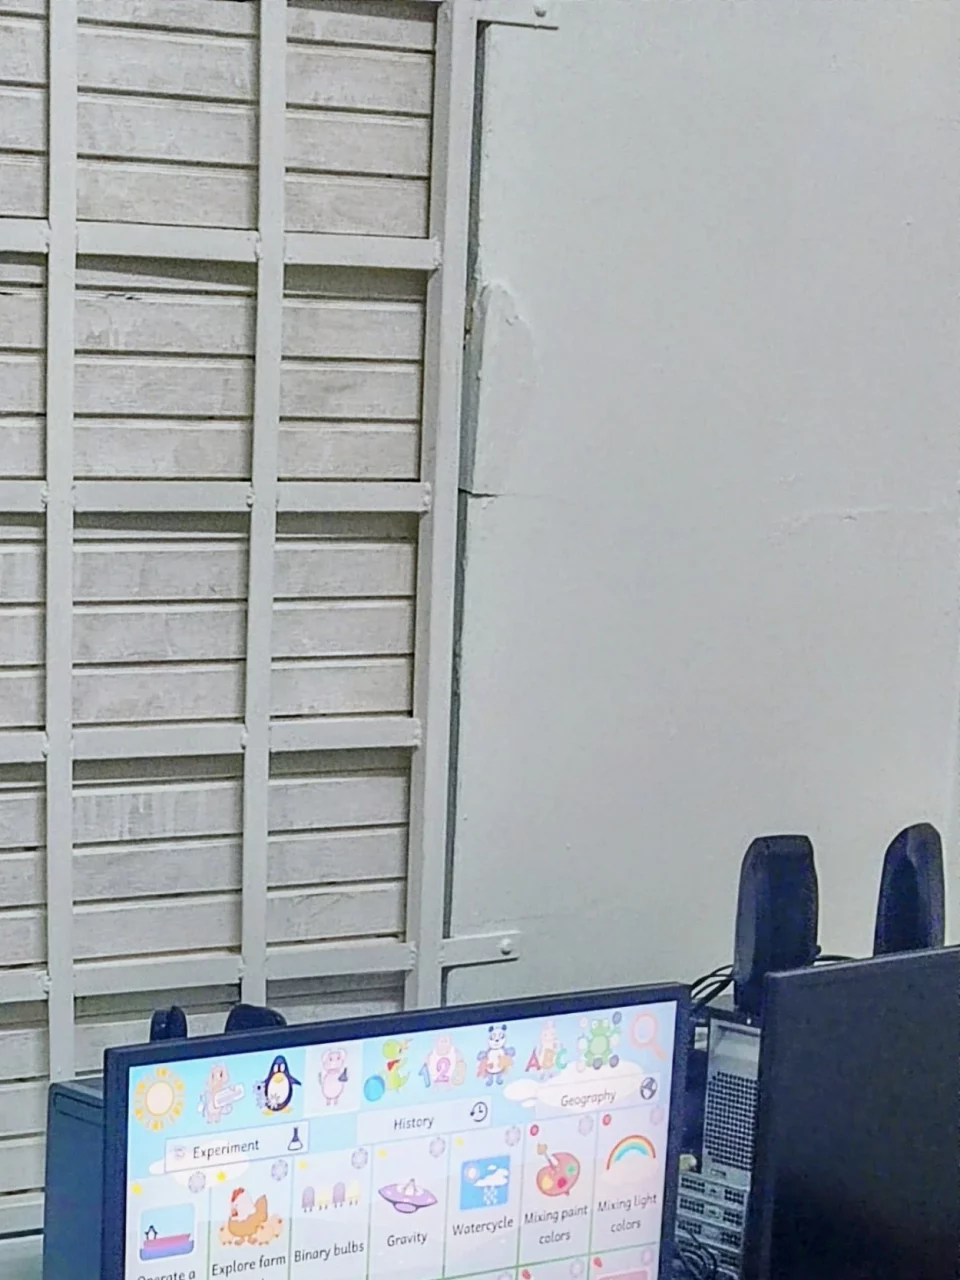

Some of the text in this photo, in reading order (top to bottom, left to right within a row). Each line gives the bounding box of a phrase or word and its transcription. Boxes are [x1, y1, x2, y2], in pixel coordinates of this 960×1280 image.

[561, 1090, 617, 1107] Geography
[393, 1116, 434, 1131] History
[193, 1139, 260, 1160] Experiment
[597, 1193, 658, 1214] Mixing light
[524, 1204, 588, 1225] Mixing paint
[452, 1216, 514, 1237] Watercycle
[610, 1219, 641, 1233] colors
[387, 1231, 428, 1248] Gravity
[539, 1230, 571, 1245] colors
[294, 1240, 365, 1264] Binary bulbs
[188, 1269, 196, 1280] a
[211, 1253, 286, 1279] Explore farm
